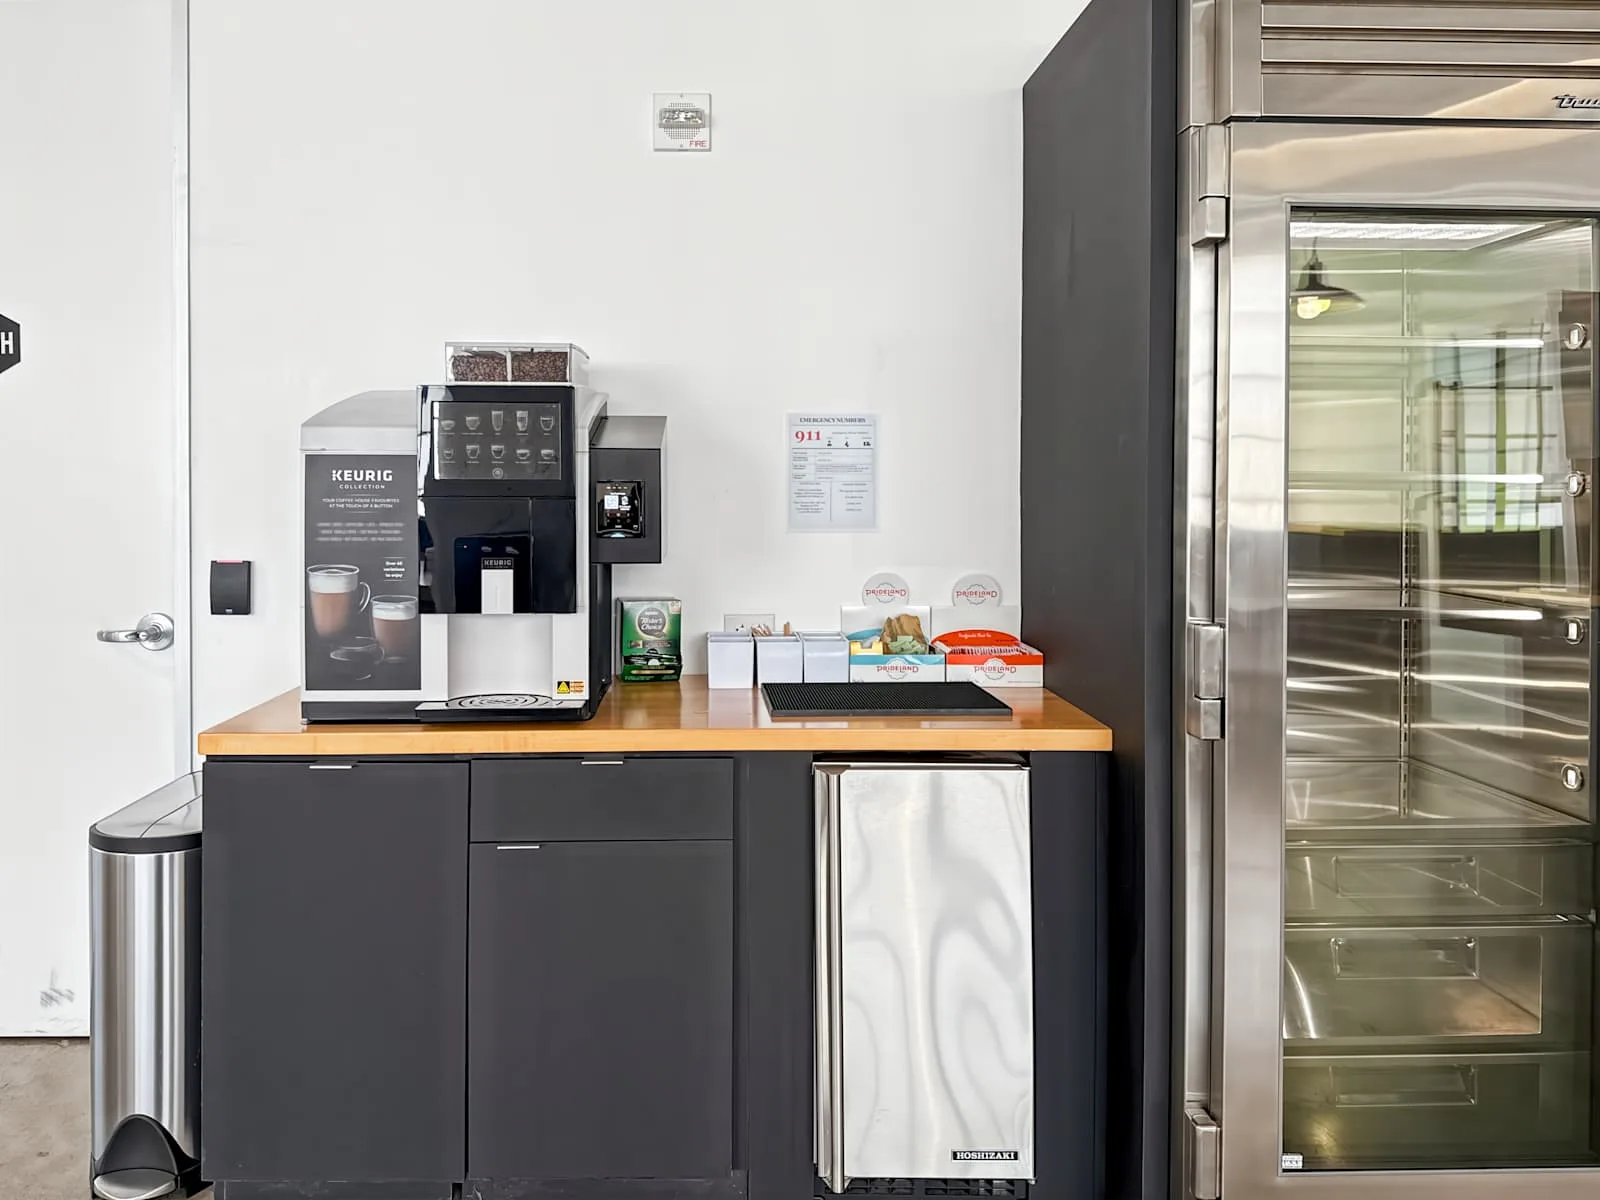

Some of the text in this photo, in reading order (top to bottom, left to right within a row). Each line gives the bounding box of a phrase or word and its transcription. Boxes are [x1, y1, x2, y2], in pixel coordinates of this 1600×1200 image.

[689, 140, 708, 148] FIRE
[795, 430, 821, 443] 911
[331, 469, 393, 482] KEURIG
[956, 1151, 1015, 1160] HOSHIZAKI
